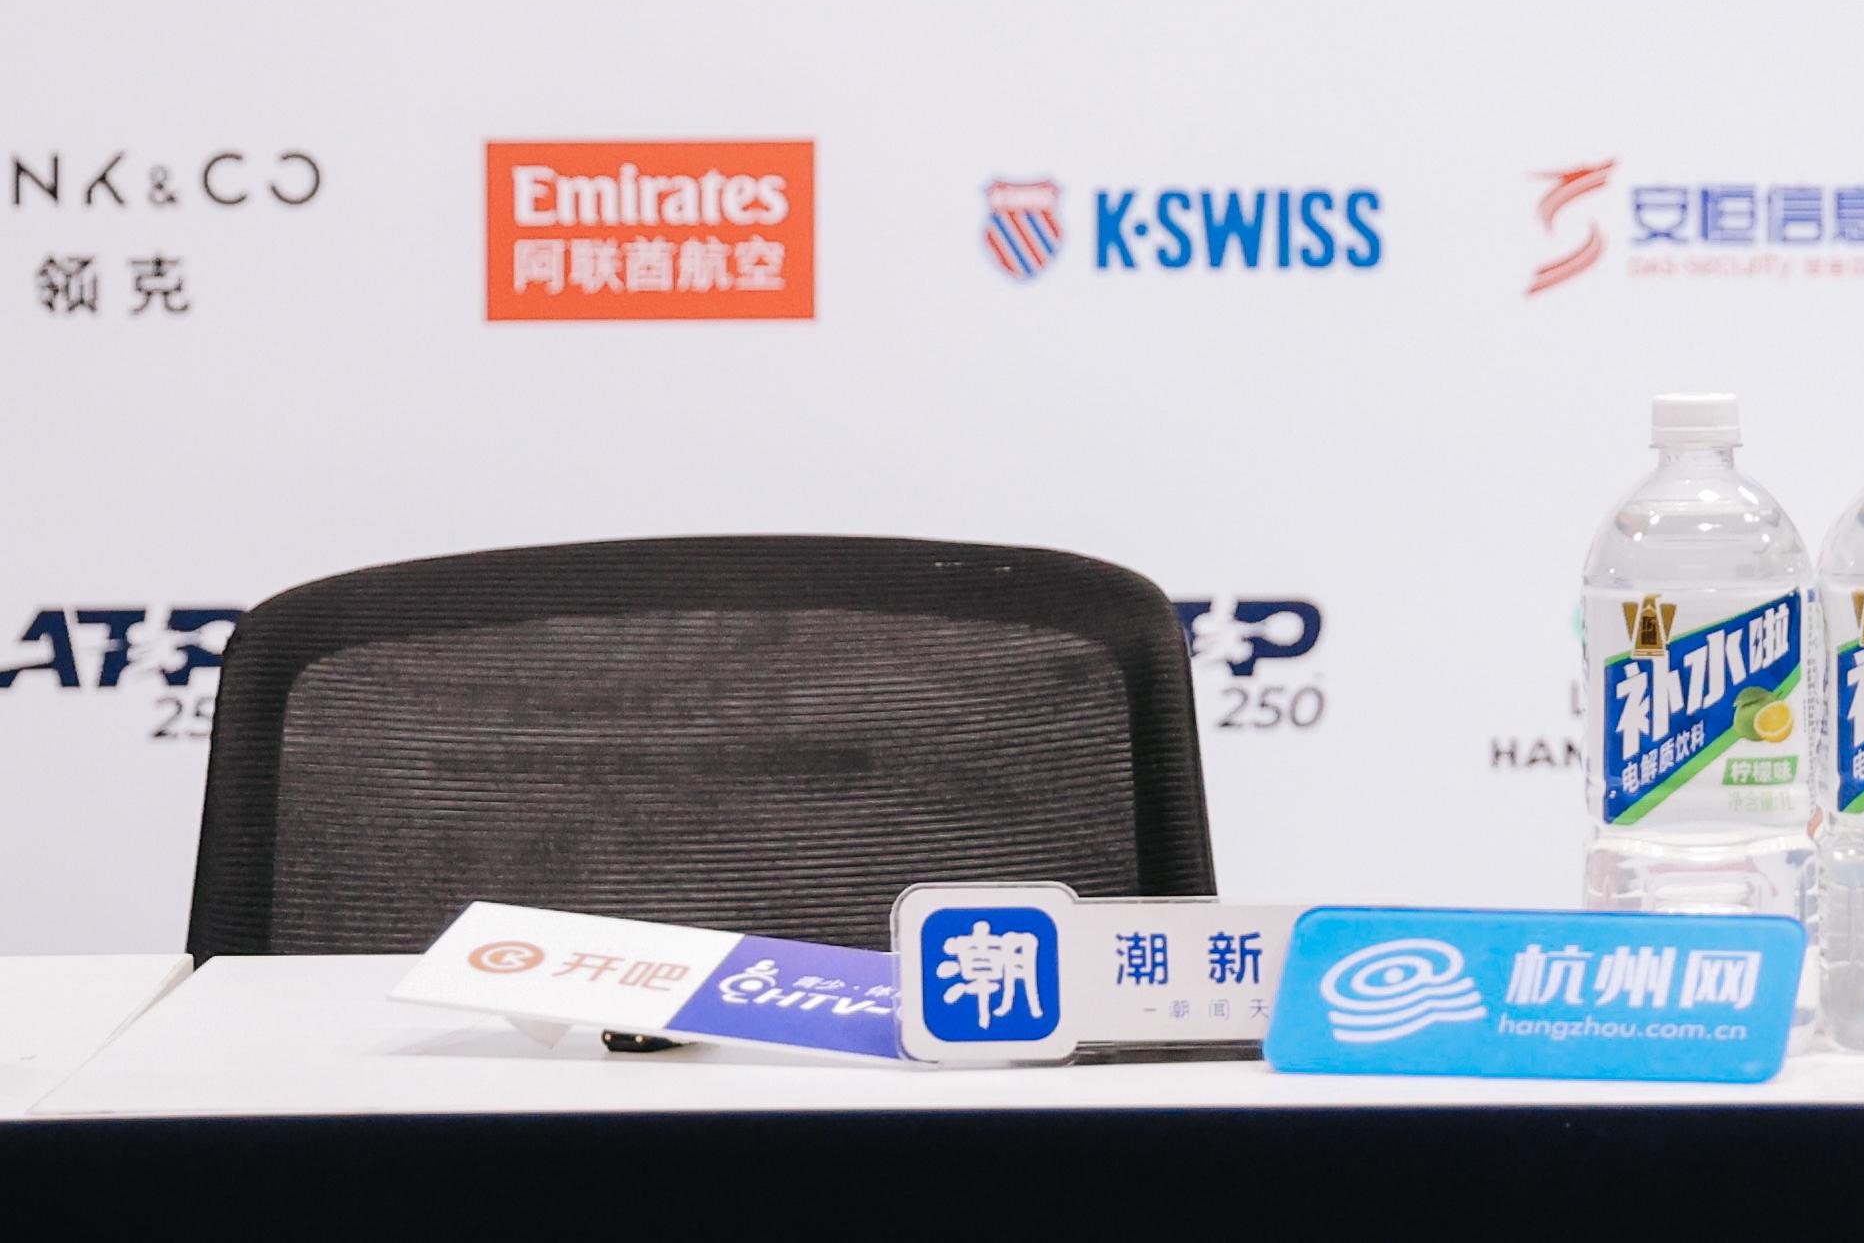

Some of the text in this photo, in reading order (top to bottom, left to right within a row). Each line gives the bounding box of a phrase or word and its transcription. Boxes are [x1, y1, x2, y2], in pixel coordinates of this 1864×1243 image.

[512, 163, 789, 226] Emirates
[37, 256, 189, 314] 领克
[513, 235, 785, 294] 阿联酋航空
[1216, 686, 1325, 730] 250
[1614, 601, 1791, 760] 补水啦
[1620, 720, 1706, 793] 电解质饮料
[553, 951, 690, 992] 开吧
[936, 920, 1043, 1029] 潮
[1115, 931, 1263, 986] 潮新
[1506, 943, 1763, 1009] 杭州网
[1499, 1014, 1748, 1041] hangzhou.com.cn
